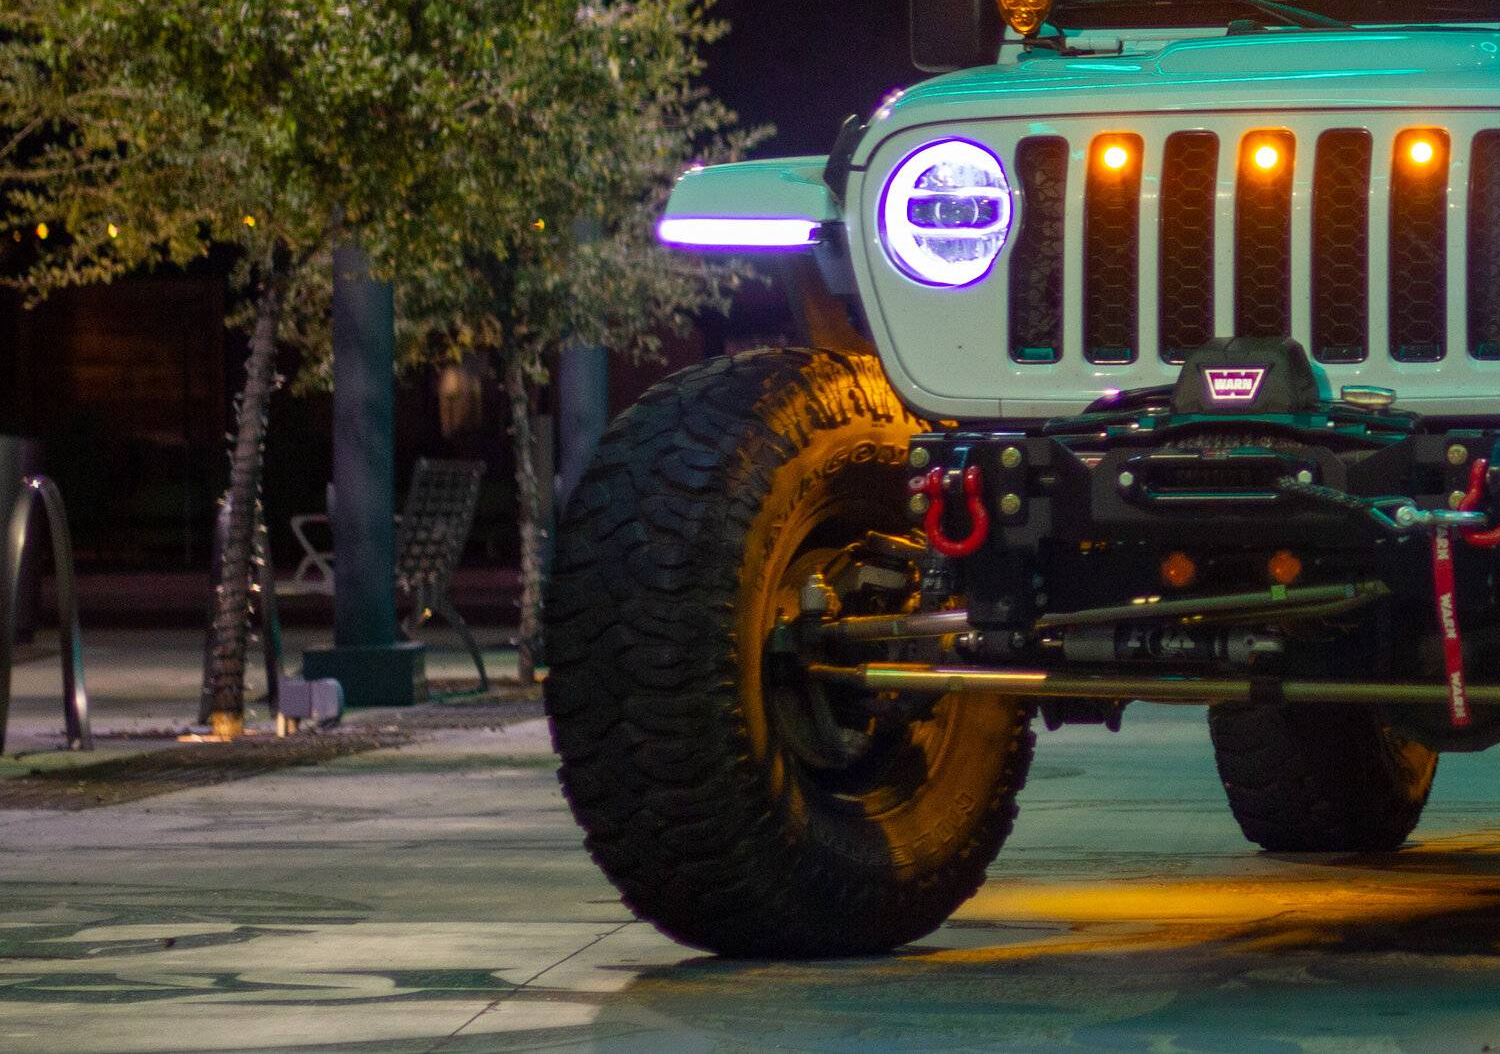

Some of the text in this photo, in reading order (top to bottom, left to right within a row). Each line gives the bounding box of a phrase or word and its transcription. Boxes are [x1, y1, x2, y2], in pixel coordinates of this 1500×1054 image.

[1214, 378, 1252, 390] WARN
[1441, 593, 1455, 638] WARN
[1451, 672, 1465, 717] WARN
